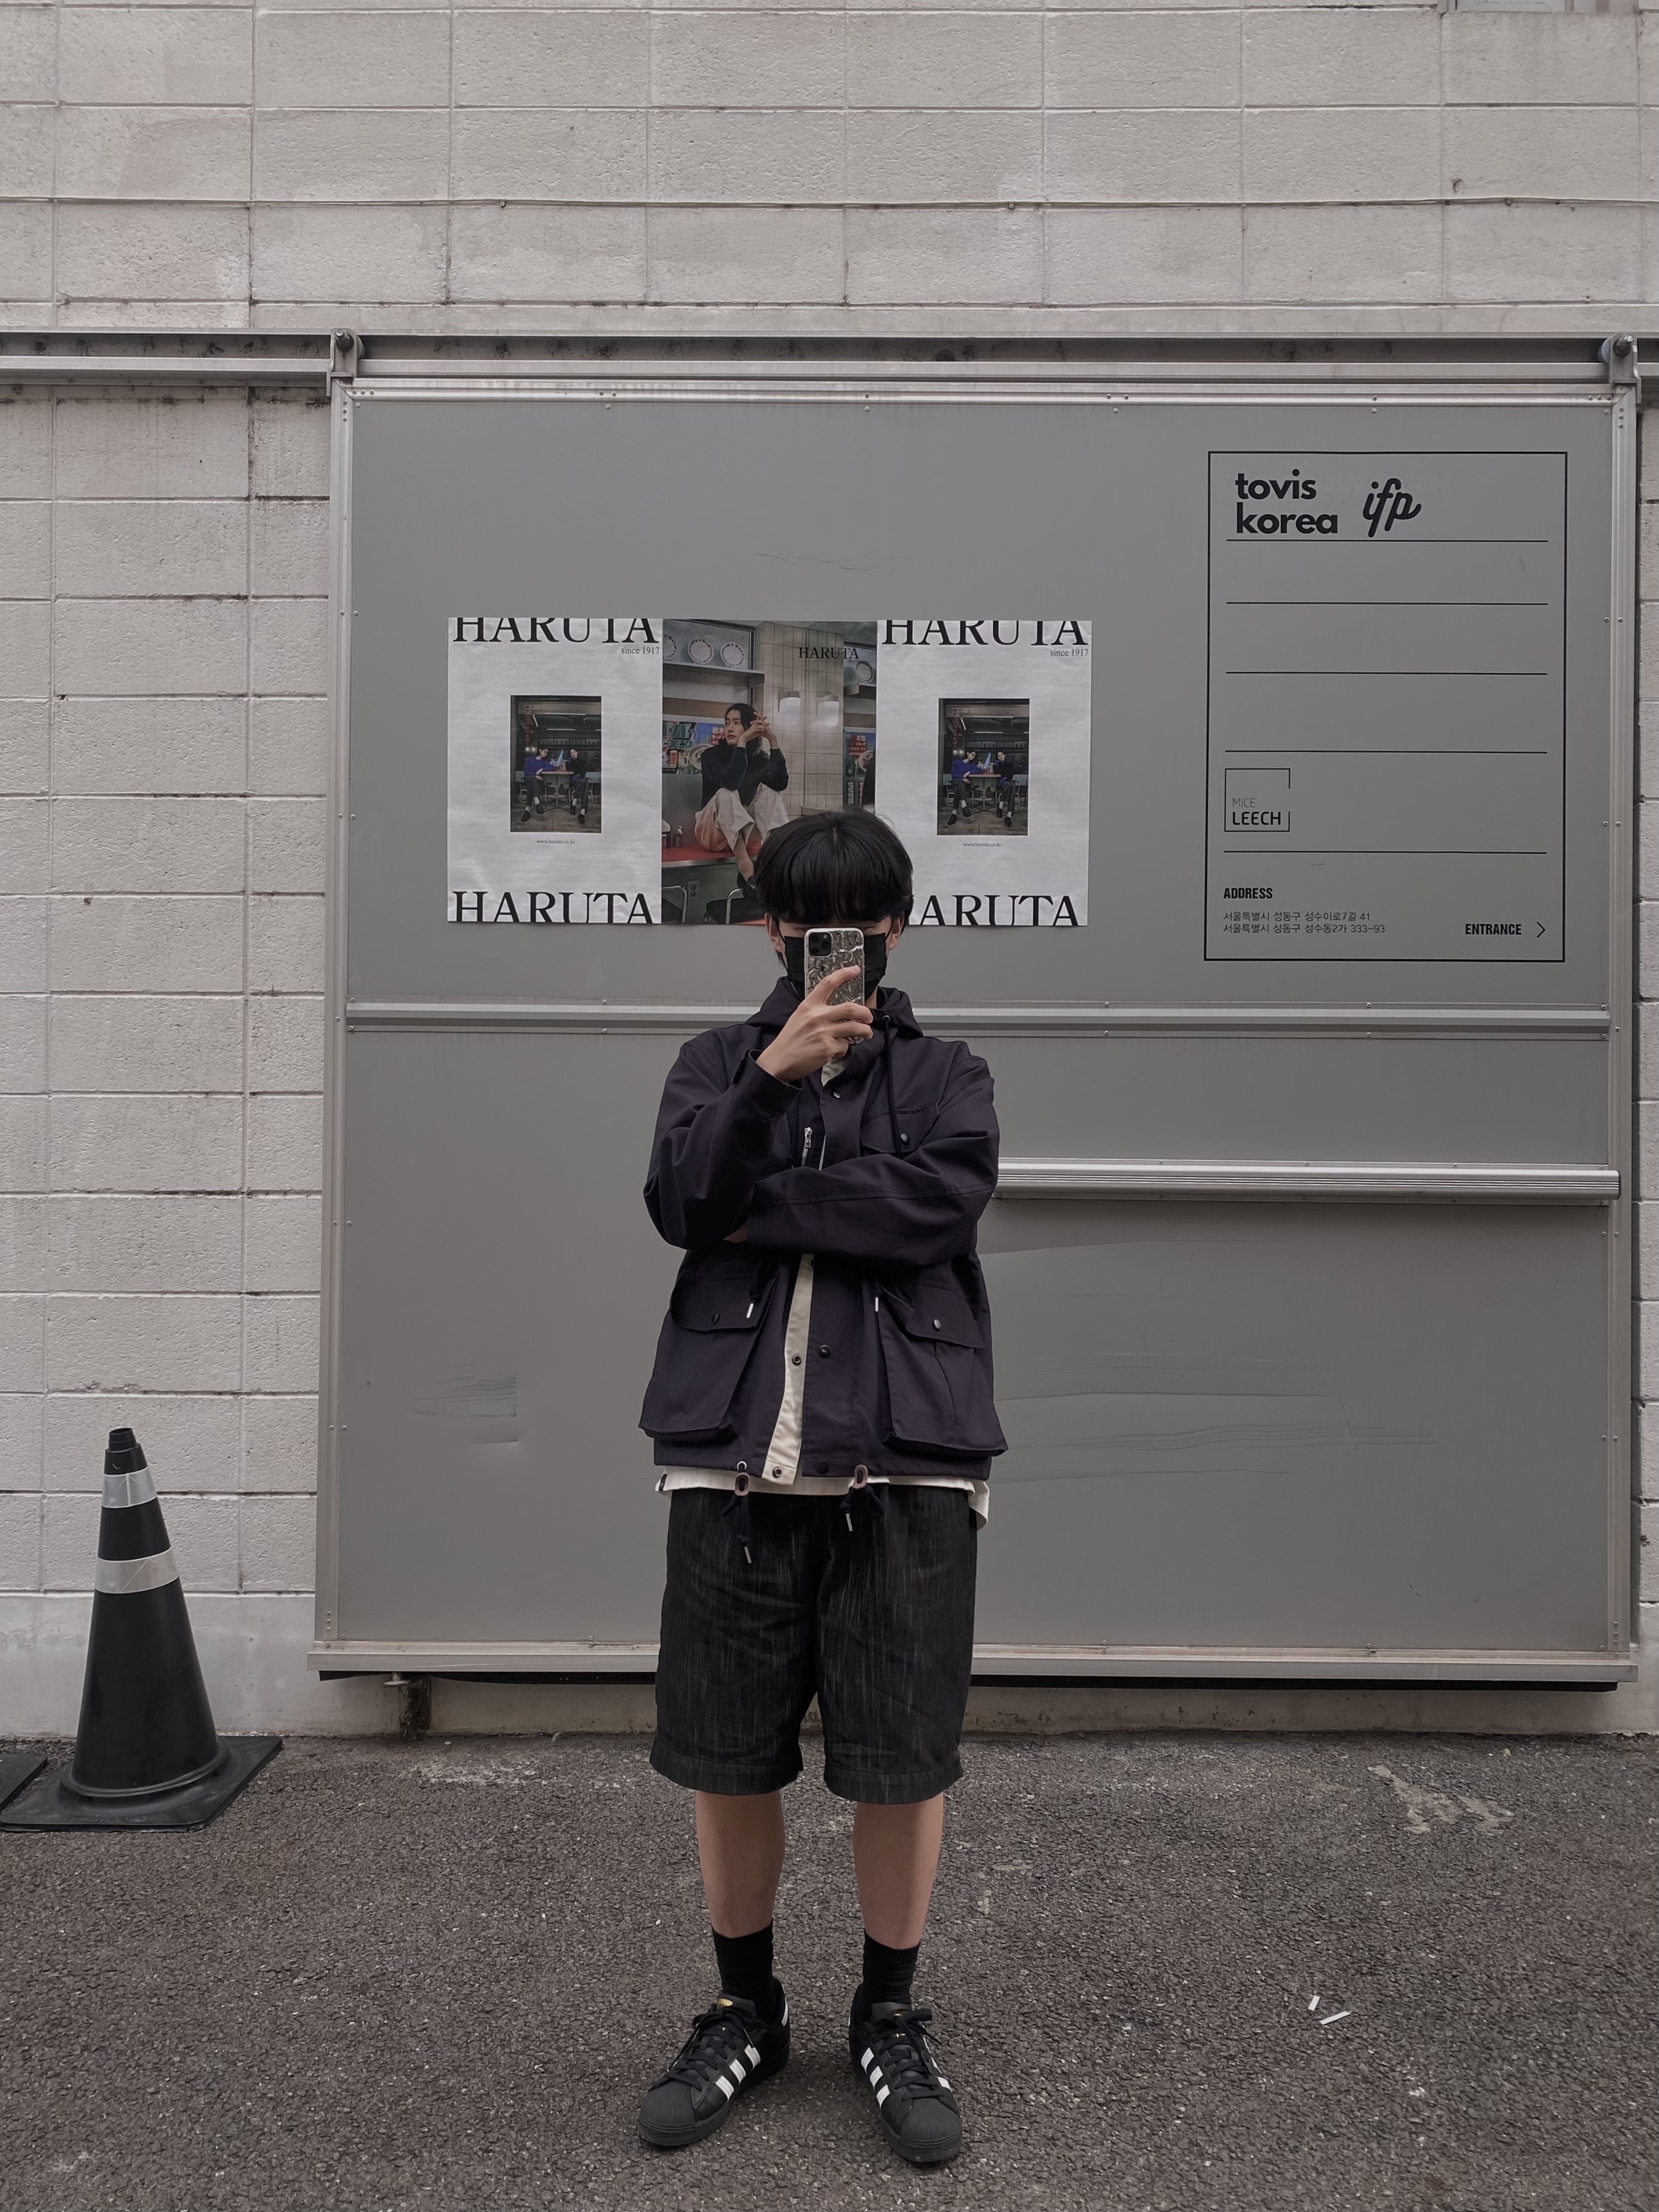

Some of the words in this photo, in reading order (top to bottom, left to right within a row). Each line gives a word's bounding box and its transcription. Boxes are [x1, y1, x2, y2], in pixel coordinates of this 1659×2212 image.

[1235, 469, 1317, 500] tovis
[1236, 502, 1338, 534] korea
[621, 646, 640, 655] since
[643, 646, 660, 655] 1917
[798, 647, 859, 659] HARUTA
[1050, 649, 1069, 657] since
[1072, 648, 1089, 656] 1917
[1232, 797, 1256, 808] MICE
[1232, 811, 1281, 825] LEECH
[1223, 888, 1273, 899] ADDRESS
[452, 891, 653, 924] HARUTA
[919, 895, 1079, 925] ARUTA
[1223, 912, 1270, 922] 서울특별시
[1273, 912, 1301, 922] 성동구
[1304, 912, 1357, 922] 성수이로7길
[1223, 923, 1270, 934] 서울특별시
[1273, 924, 1301, 934] 성동구
[1304, 924, 1348, 934] 성수동2가
[1350, 924, 1385, 934] 333-93
[1465, 923, 1522, 936] ENTRANCE
